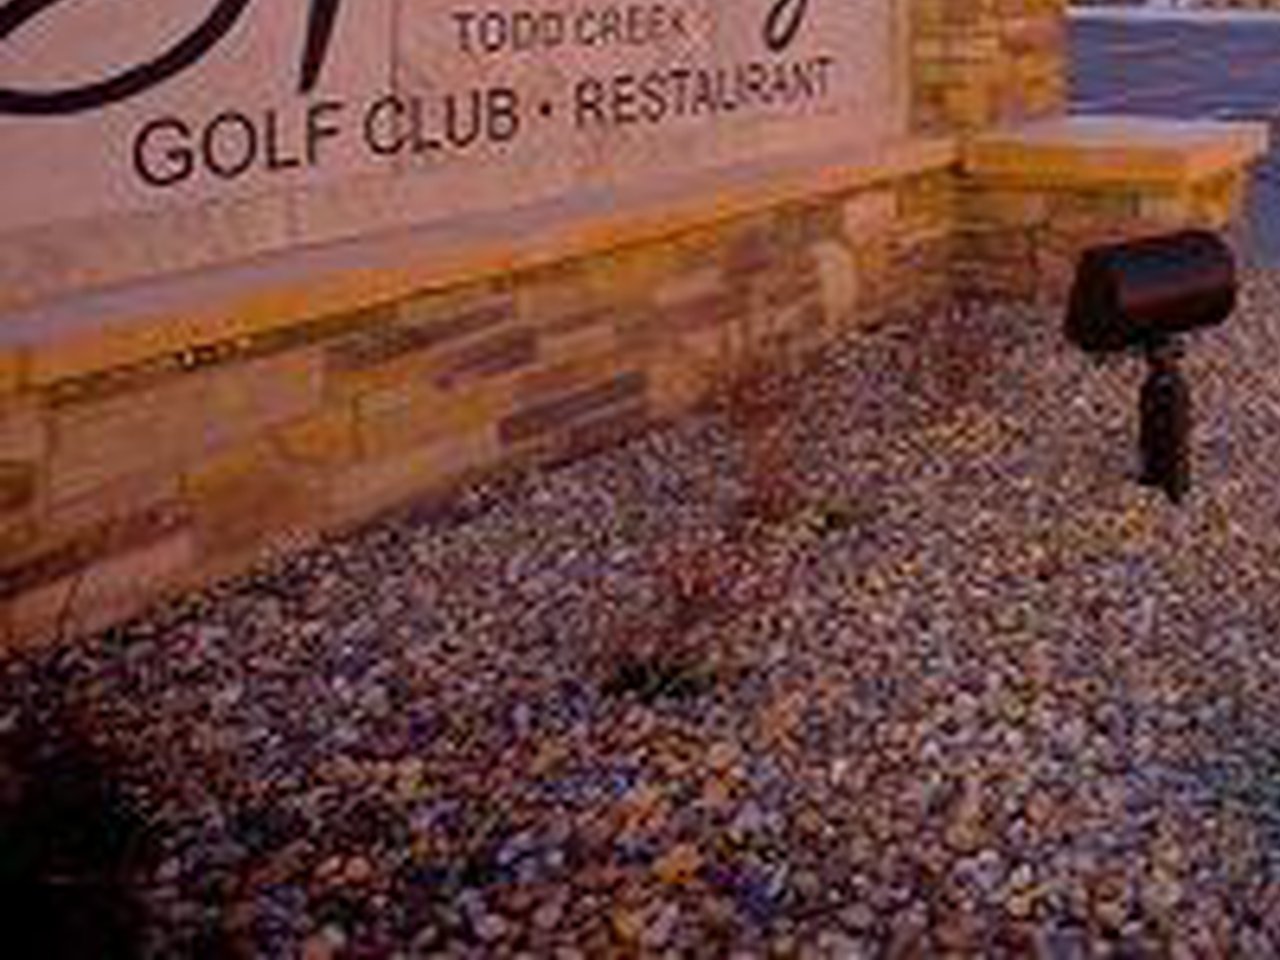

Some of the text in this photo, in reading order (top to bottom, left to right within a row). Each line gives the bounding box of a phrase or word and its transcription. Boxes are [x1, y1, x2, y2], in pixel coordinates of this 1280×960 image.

[452, 4, 687, 53] TODD CREEK
[132, 57, 834, 187] GOLF CLUB RESTAURANT
